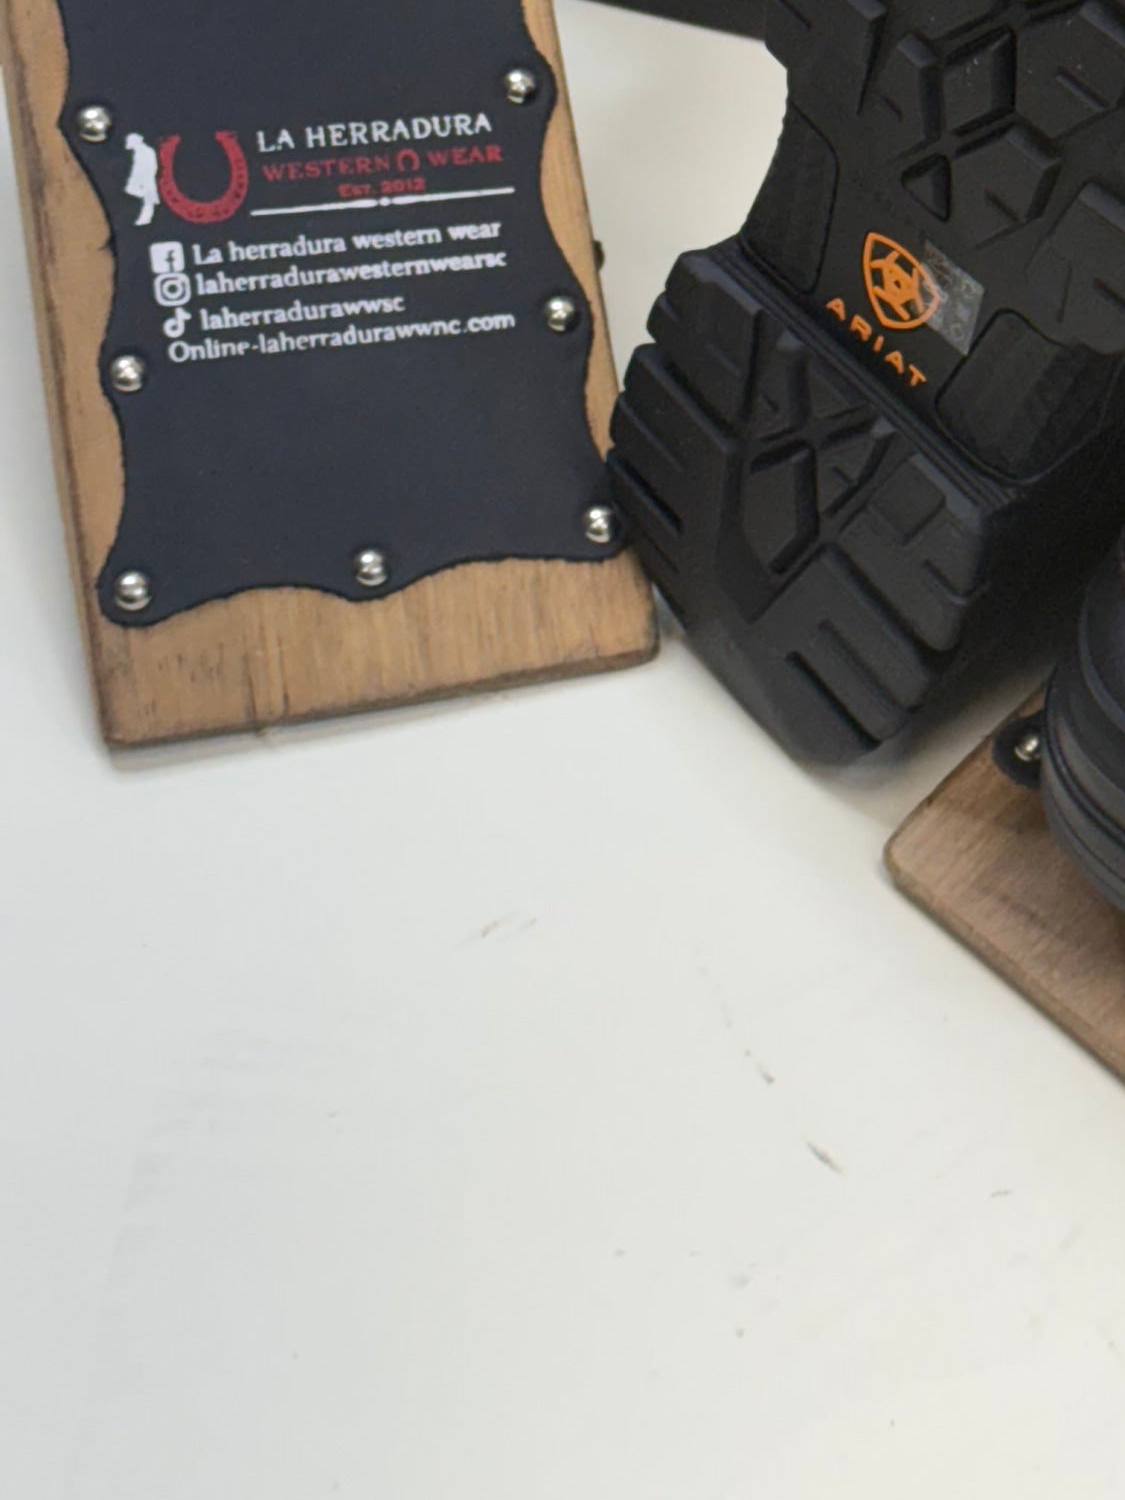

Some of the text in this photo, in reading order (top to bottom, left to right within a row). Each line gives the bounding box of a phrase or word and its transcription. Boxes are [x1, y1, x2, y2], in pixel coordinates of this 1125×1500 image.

[256, 112, 492, 152] LA HERRADURA
[262, 144, 503, 182] WESTERN WEAR
[192, 221, 502, 266] La herradura western wear
[826, 297, 928, 388] ARIAT
